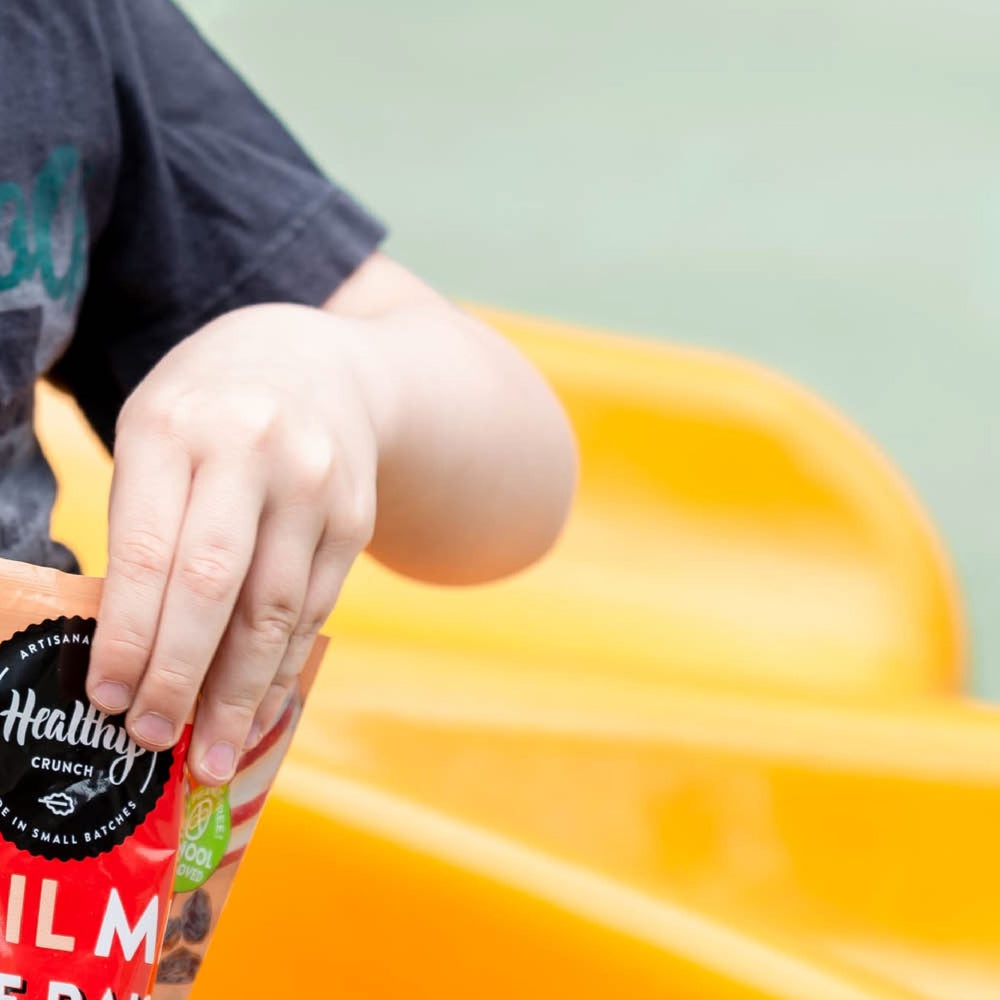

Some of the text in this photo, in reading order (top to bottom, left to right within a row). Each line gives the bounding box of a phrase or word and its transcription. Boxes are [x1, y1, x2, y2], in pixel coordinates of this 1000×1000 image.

[0, 688, 147, 786] Healthy
[31, 756, 94, 778] CRUNCH
[12, 816, 28, 832] IN
[31, 826, 78, 845] SMALL
[85, 801, 137, 842] BATCHES
[93, 887, 159, 964] M
